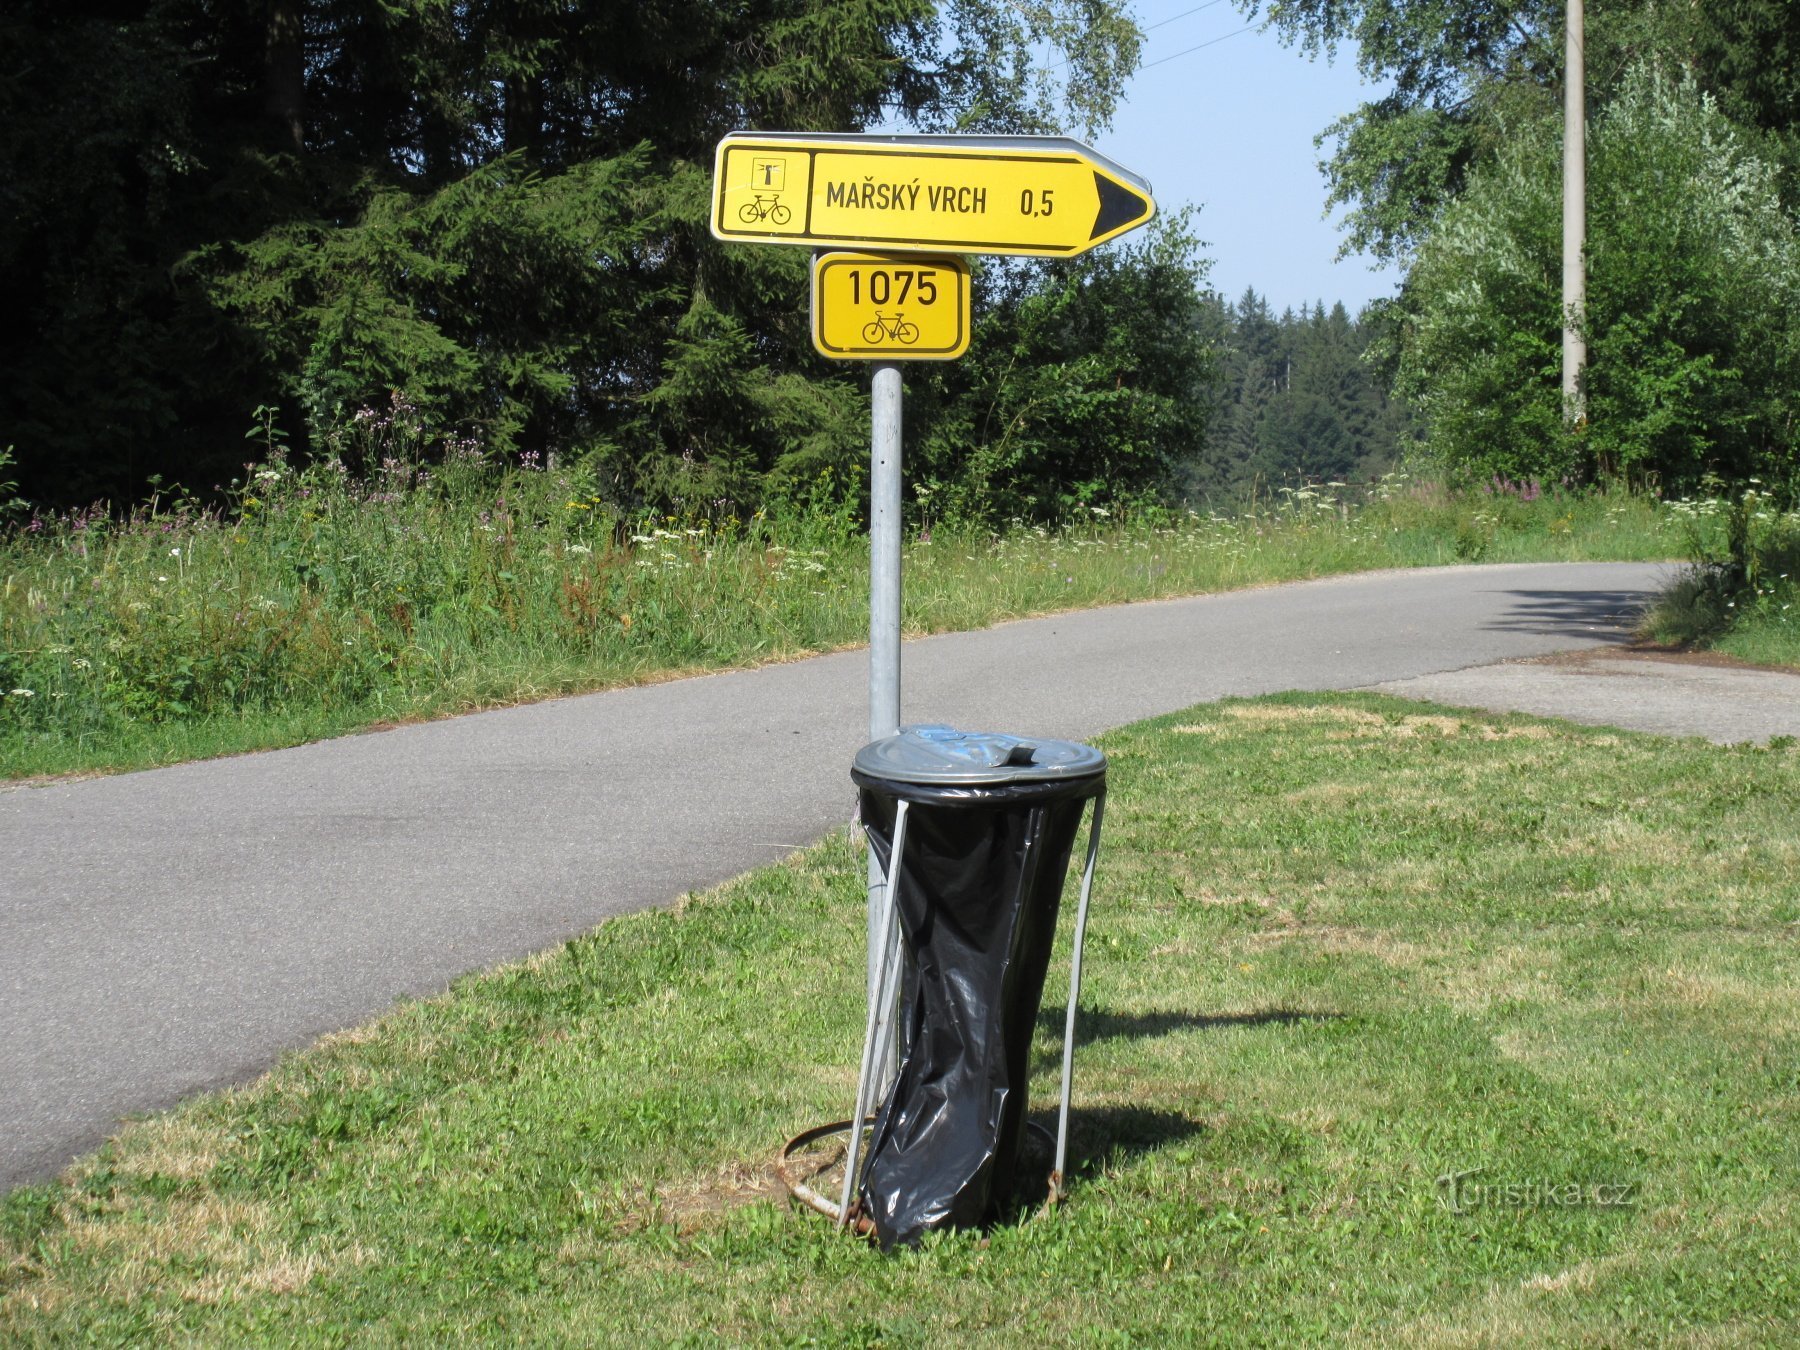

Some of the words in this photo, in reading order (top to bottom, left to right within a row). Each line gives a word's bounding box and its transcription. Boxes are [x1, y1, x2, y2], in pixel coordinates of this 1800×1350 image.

[826, 175, 921, 211] MAŘSKÝ
[927, 185, 987, 214] VRCH
[1020, 188, 1054, 218] 0,5
[849, 270, 937, 306] 1075
